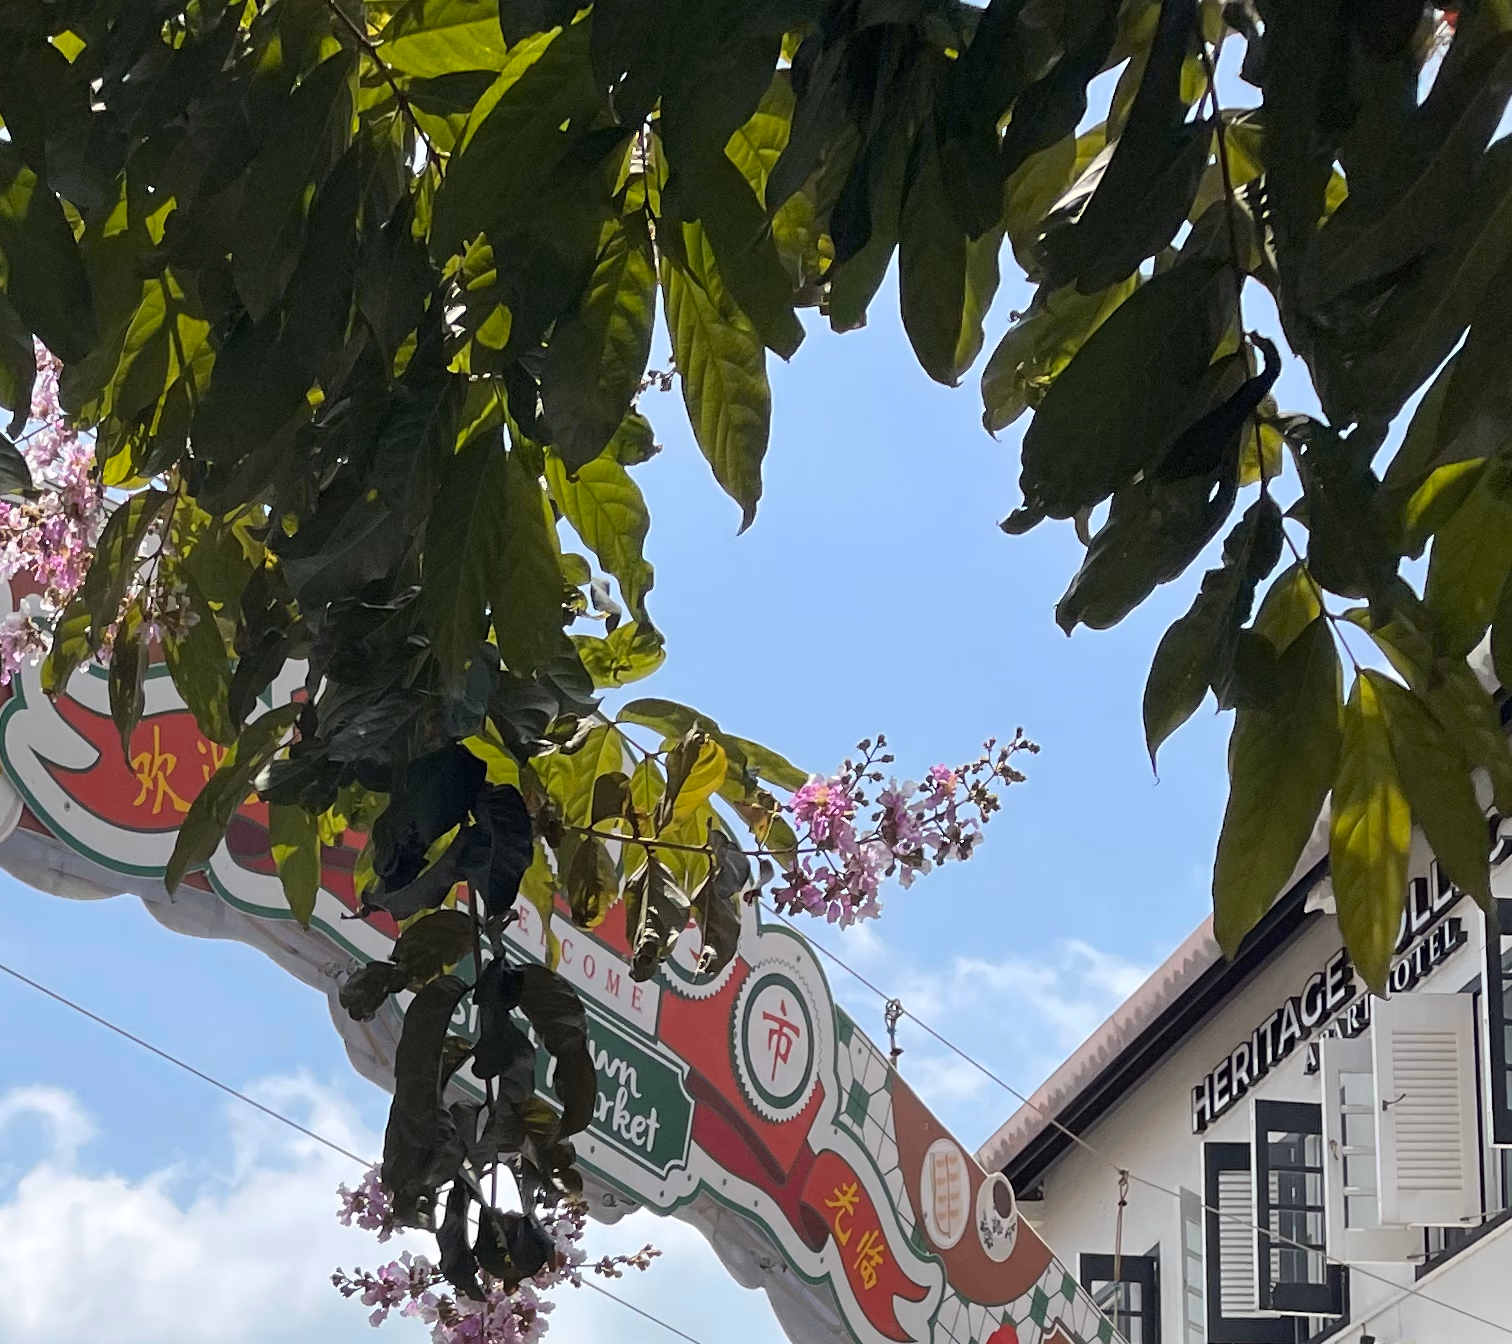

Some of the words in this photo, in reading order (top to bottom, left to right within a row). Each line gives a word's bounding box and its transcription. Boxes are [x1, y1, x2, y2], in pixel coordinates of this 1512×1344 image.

[762, 999, 800, 1081] 市
[1191, 947, 1354, 1134] HERITAGE
[824, 1181, 885, 1291] 光临
